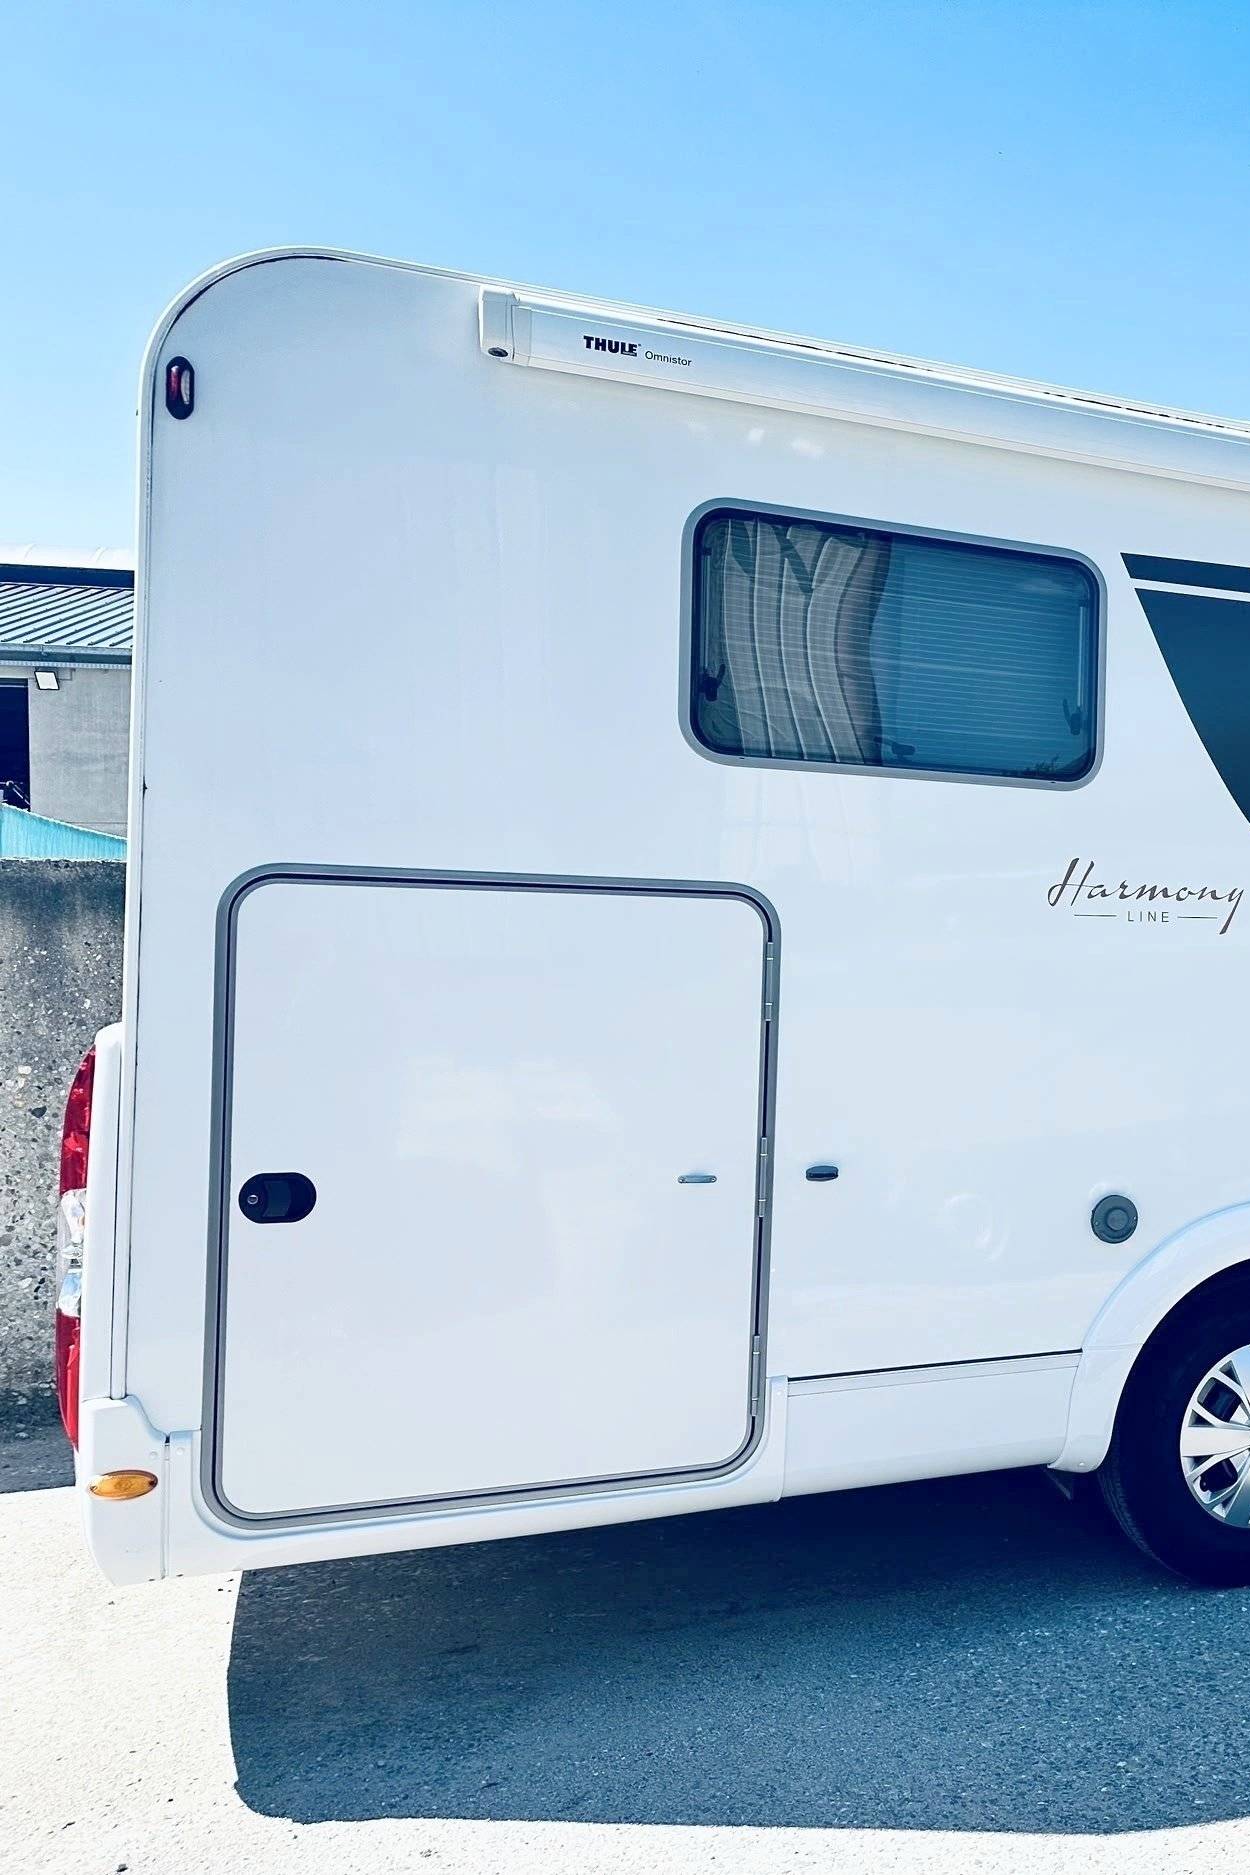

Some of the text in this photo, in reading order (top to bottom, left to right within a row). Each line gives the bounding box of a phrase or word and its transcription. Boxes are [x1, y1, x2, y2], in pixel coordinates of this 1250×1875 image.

[583, 335, 692, 366] THULE Omnistor
[1048, 857, 1244, 935] Harmony
[1127, 911, 1170, 923] LINE
